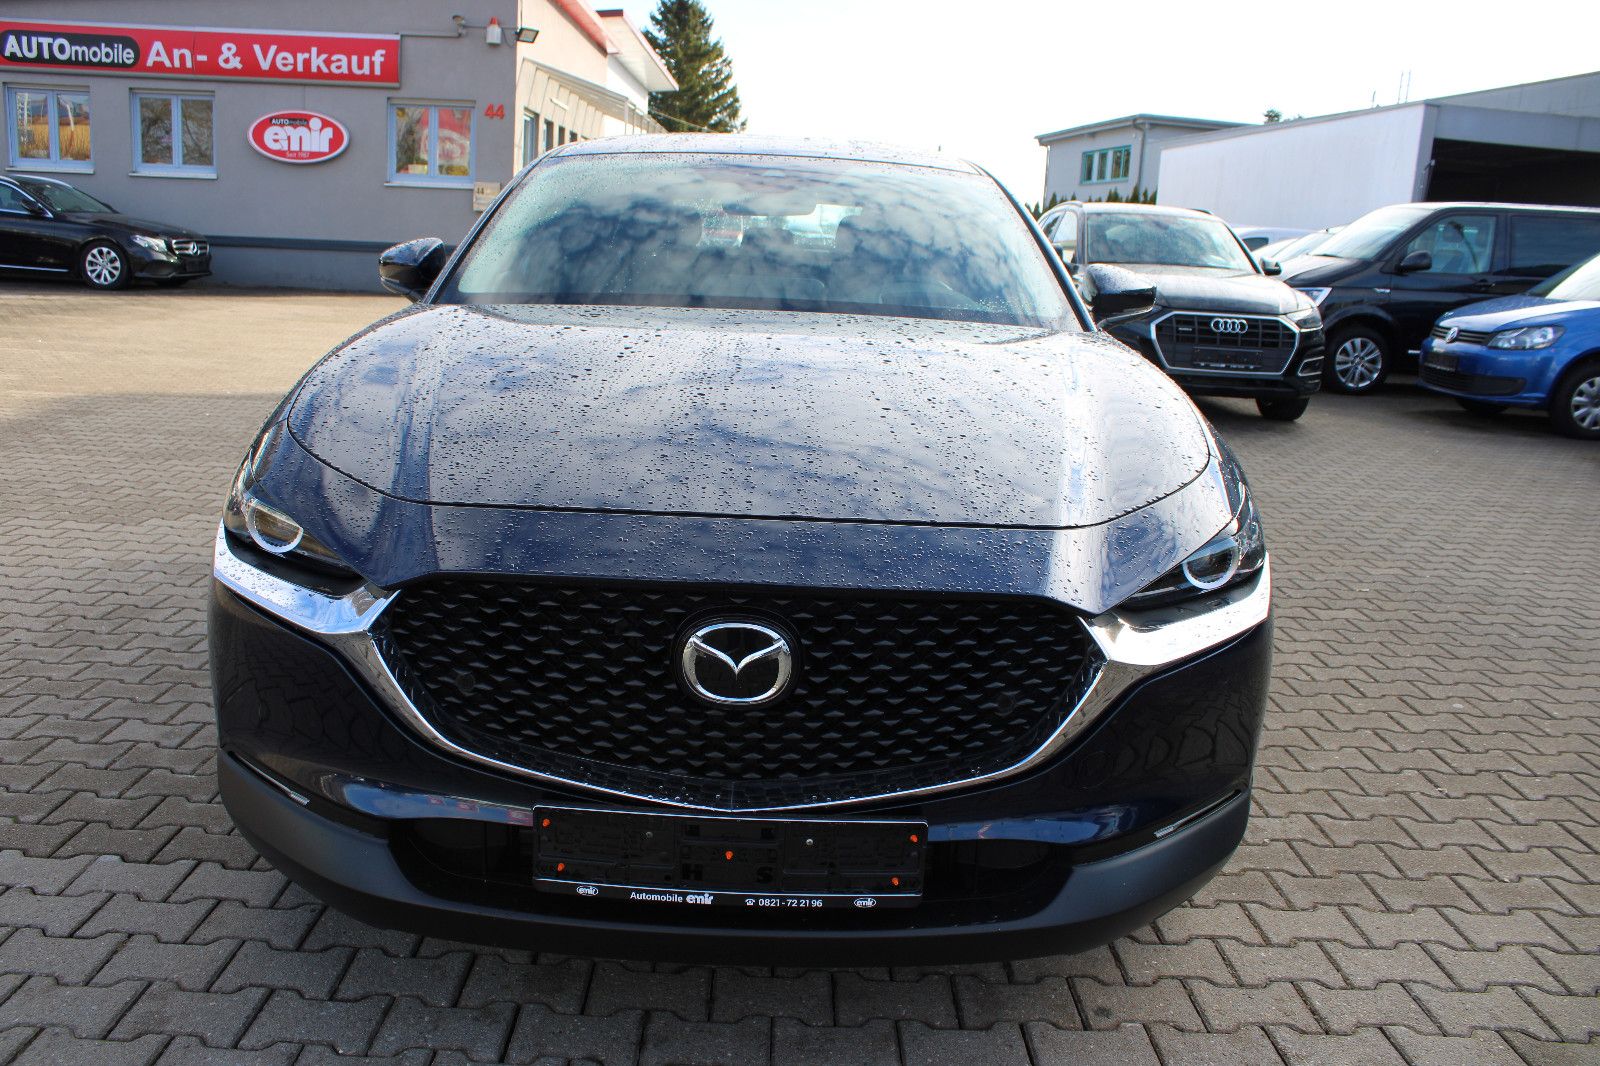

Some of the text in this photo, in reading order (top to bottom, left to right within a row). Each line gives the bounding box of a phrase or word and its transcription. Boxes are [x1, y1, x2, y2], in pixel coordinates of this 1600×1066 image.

[4, 35, 386, 76] AUTOmobile An- & Verkauf
[484, 103, 505, 120] 44
[264, 117, 333, 153] emir
[578, 886, 596, 895] emir
[630, 891, 714, 905] Automobile emir
[856, 899, 874, 907] emir
